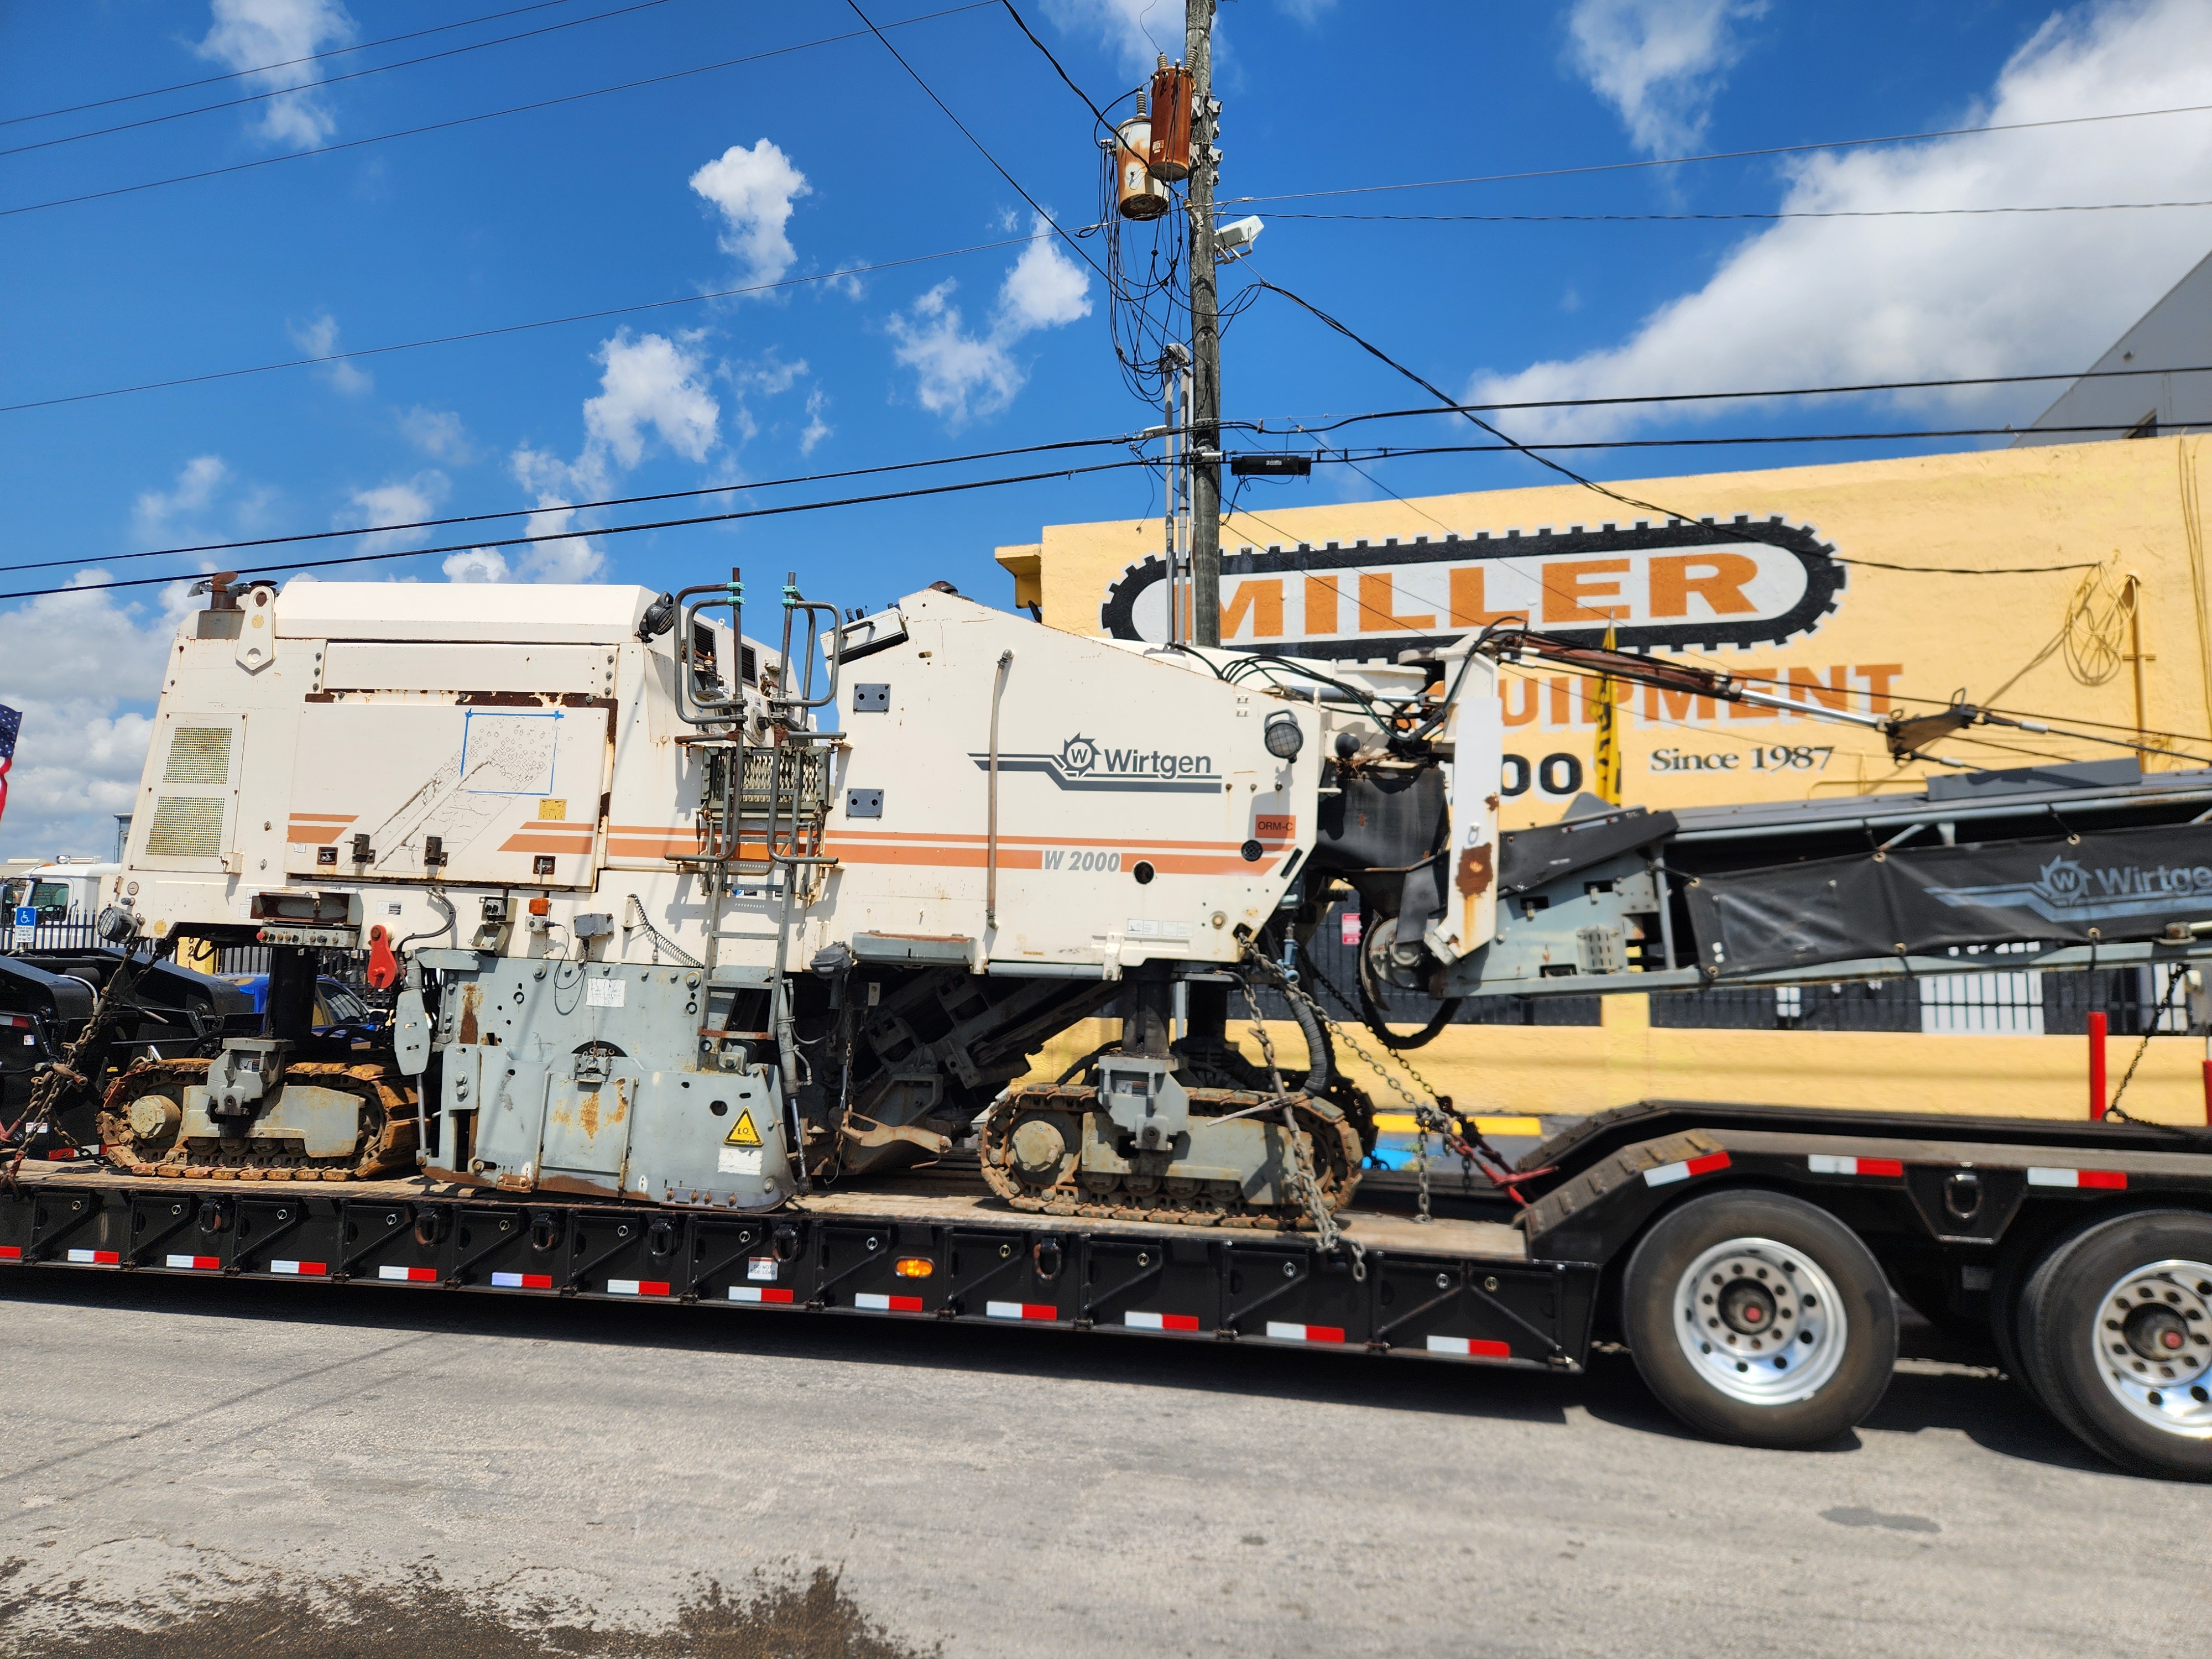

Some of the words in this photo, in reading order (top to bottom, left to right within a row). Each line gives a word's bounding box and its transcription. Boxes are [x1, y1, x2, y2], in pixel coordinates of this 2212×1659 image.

[1174, 554, 1759, 640] MILLER
[1396, 663, 1903, 730] UIPMENT
[1071, 749, 1088, 763] W
[1104, 749, 1211, 779] Wirtgen
[1651, 748, 1739, 771] Since
[1750, 745, 1835, 773] 1987
[1258, 821, 1293, 831] ORM-C
[1045, 850, 1065, 870] W
[1068, 851, 1120, 872] 2000
[2052, 872, 2075, 890] W
[2094, 864, 2212, 897] Wirtge
